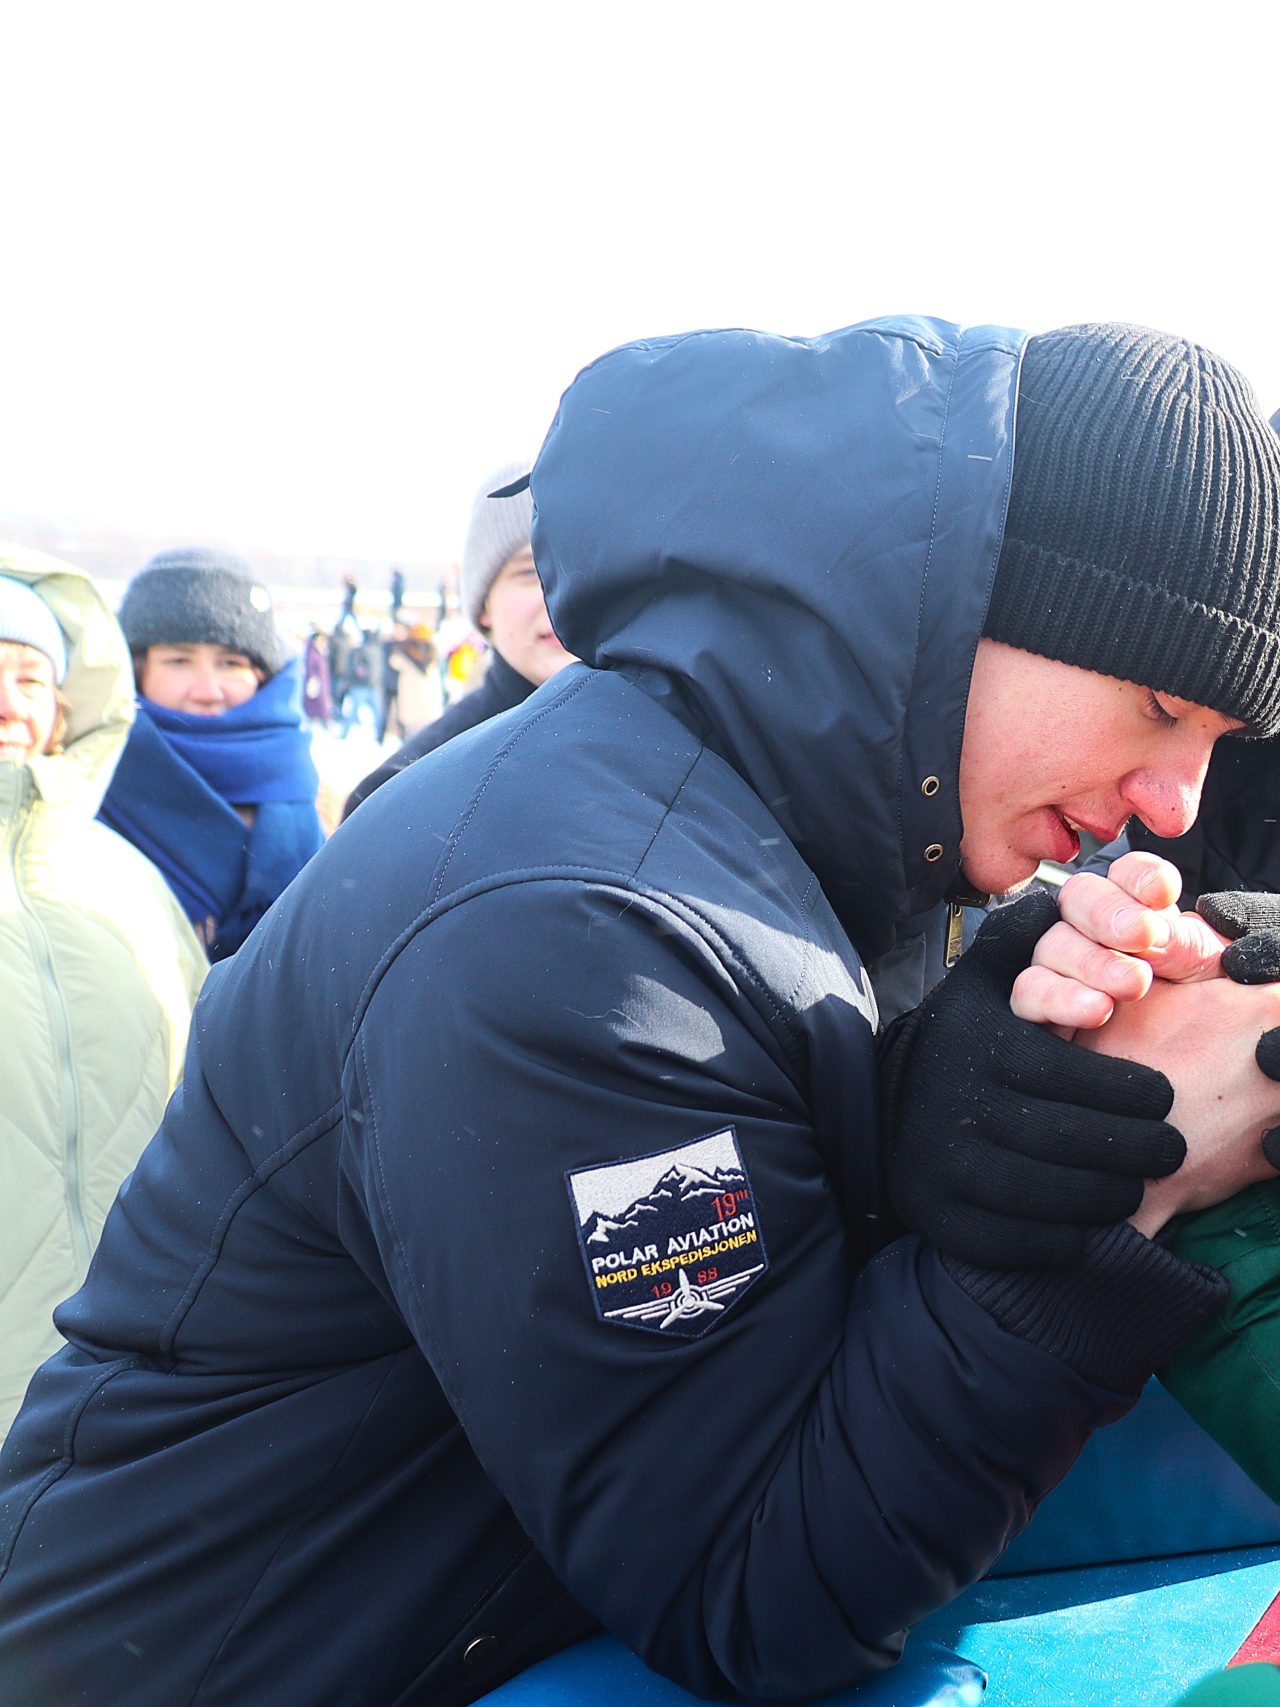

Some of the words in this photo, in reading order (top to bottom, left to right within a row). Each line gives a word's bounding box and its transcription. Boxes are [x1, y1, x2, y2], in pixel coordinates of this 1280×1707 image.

[591, 1244, 659, 1274] POLAR
[667, 1212, 754, 1255] AVIATION
[595, 1266, 638, 1289] NORD
[641, 1229, 757, 1276] EKSPEDISJONEN
[650, 1282, 672, 1299] 19
